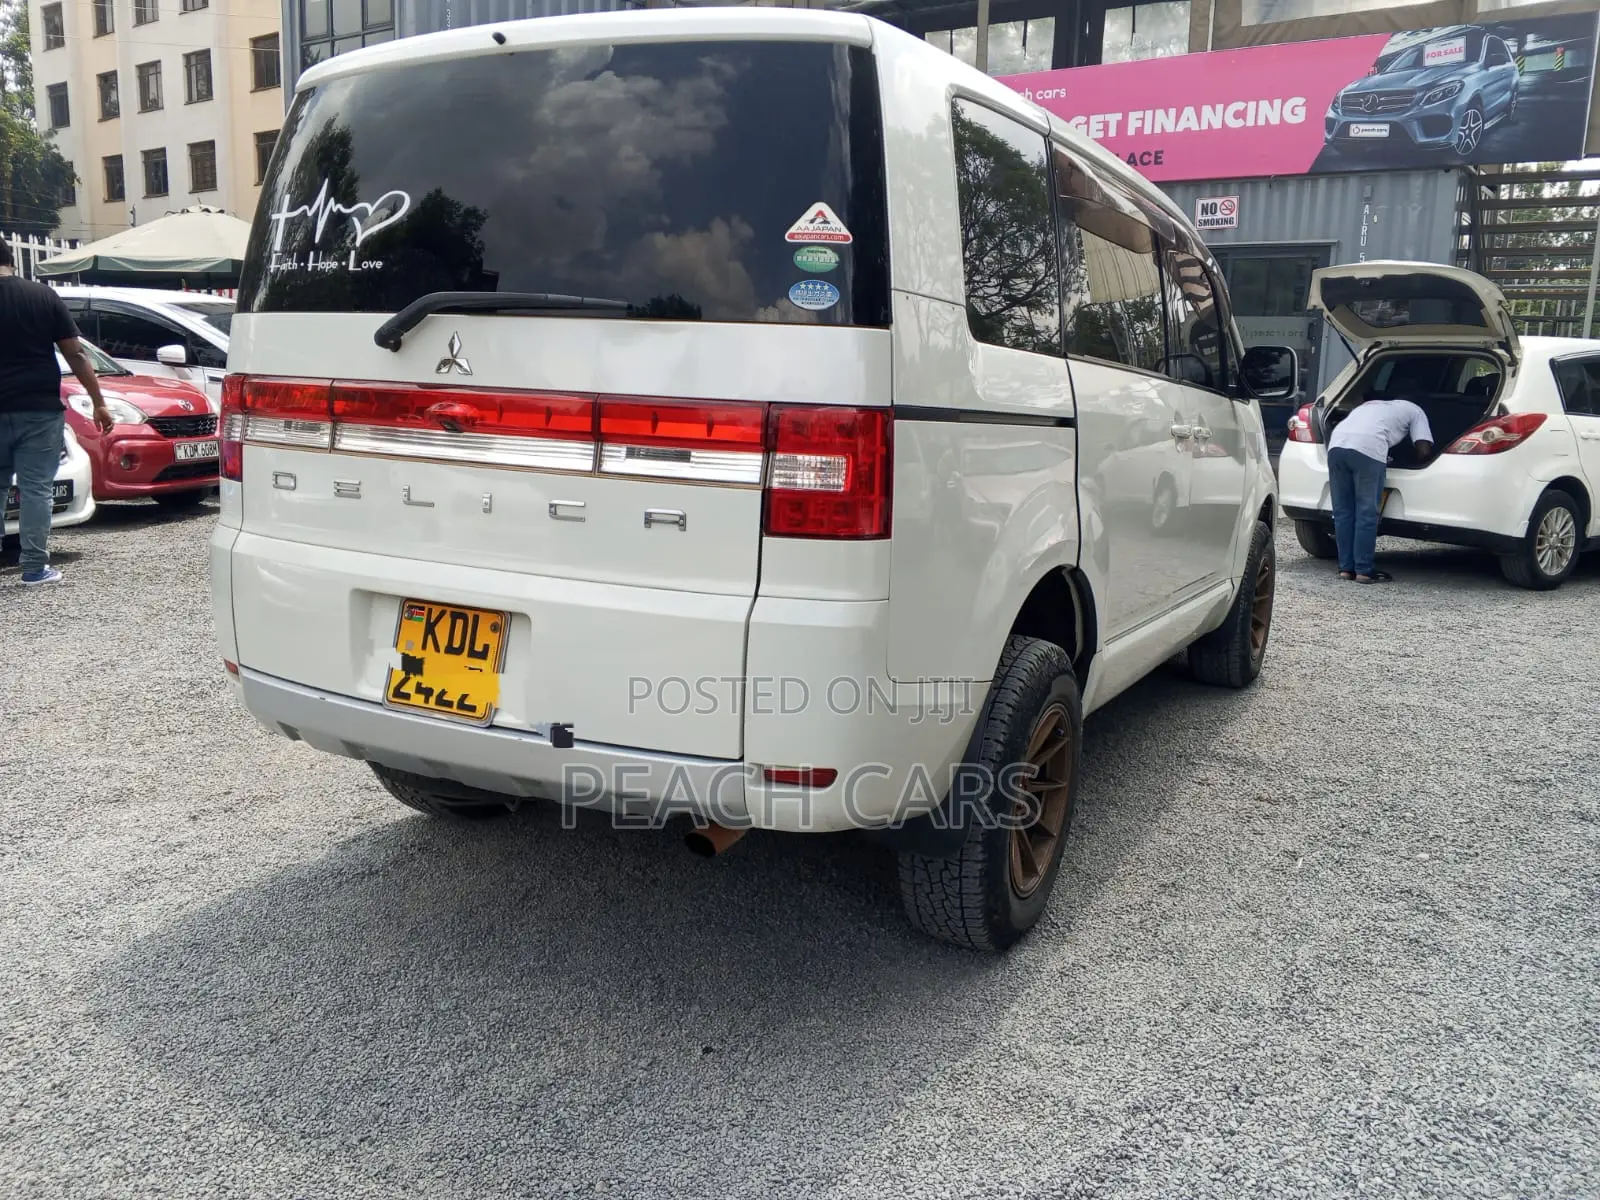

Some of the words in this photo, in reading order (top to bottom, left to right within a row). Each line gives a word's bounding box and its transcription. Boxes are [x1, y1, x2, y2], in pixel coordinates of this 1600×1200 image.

[1426, 50, 1442, 60] FOR
[1443, 46, 1464, 56] SALE
[1036, 88, 1067, 100] cars
[1067, 112, 1123, 139] GET
[1127, 96, 1307, 136] FINANCING
[1200, 202, 1218, 216] NO
[1198, 217, 1235, 227] SMOKING
[270, 253, 298, 273] Faith
[307, 250, 338, 272] Hope
[348, 250, 384, 271] Love
[272, 471, 687, 531] DELICA
[421, 607, 490, 660] KDL
